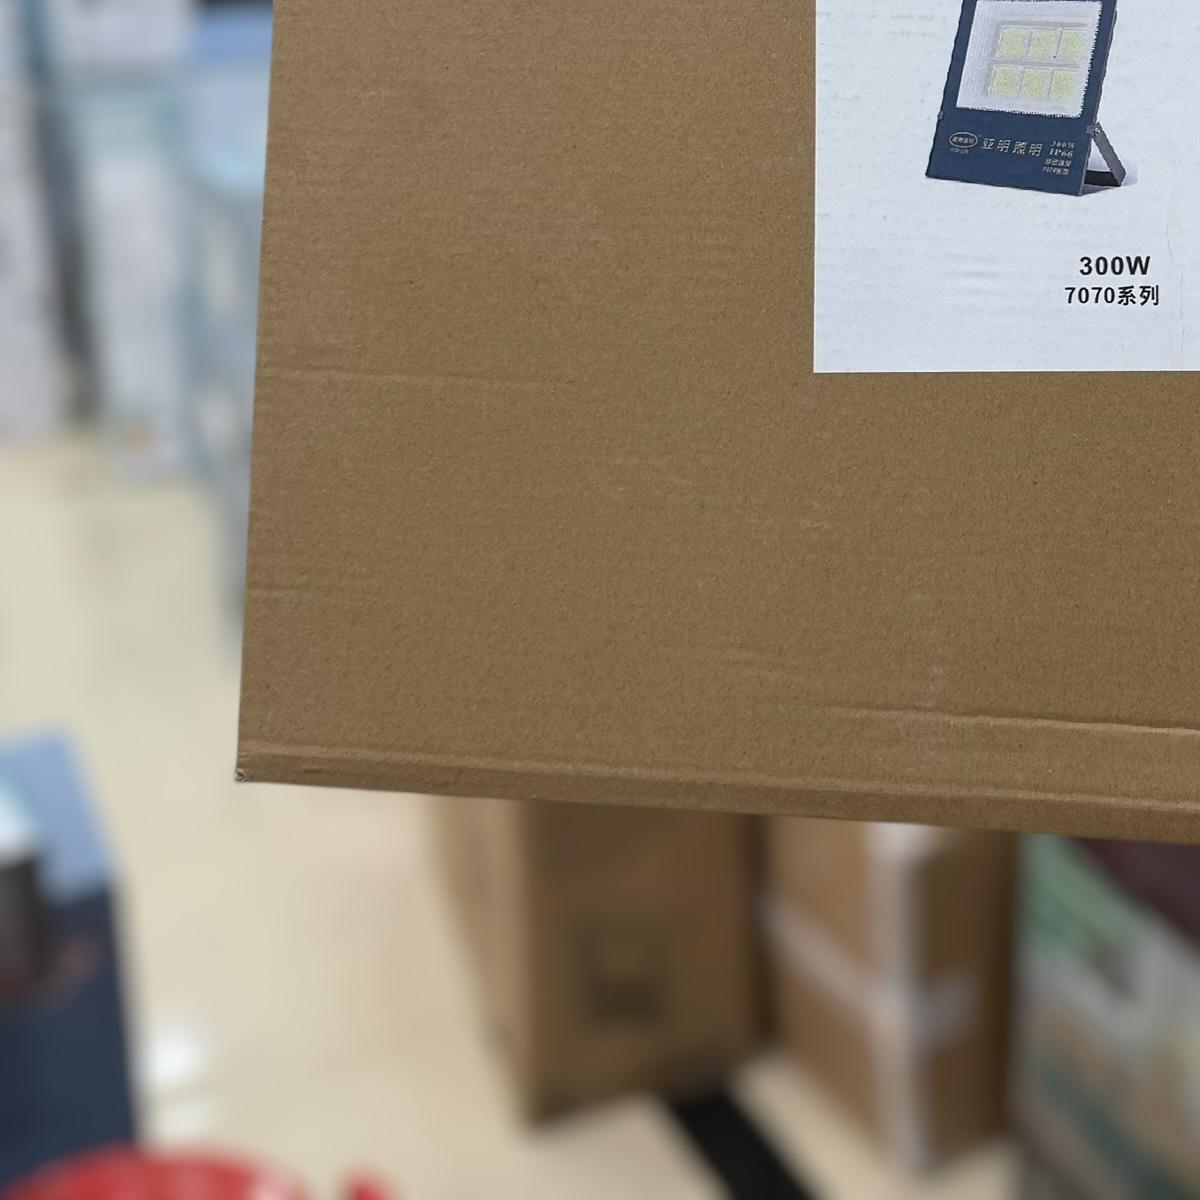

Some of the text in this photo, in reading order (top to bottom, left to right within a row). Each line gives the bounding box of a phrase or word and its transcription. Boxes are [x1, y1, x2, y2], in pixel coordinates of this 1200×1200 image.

[981, 138, 1043, 157] 亚明照明
[1079, 256, 1151, 276] 300W
[1065, 285, 1159, 306] 7070系列
